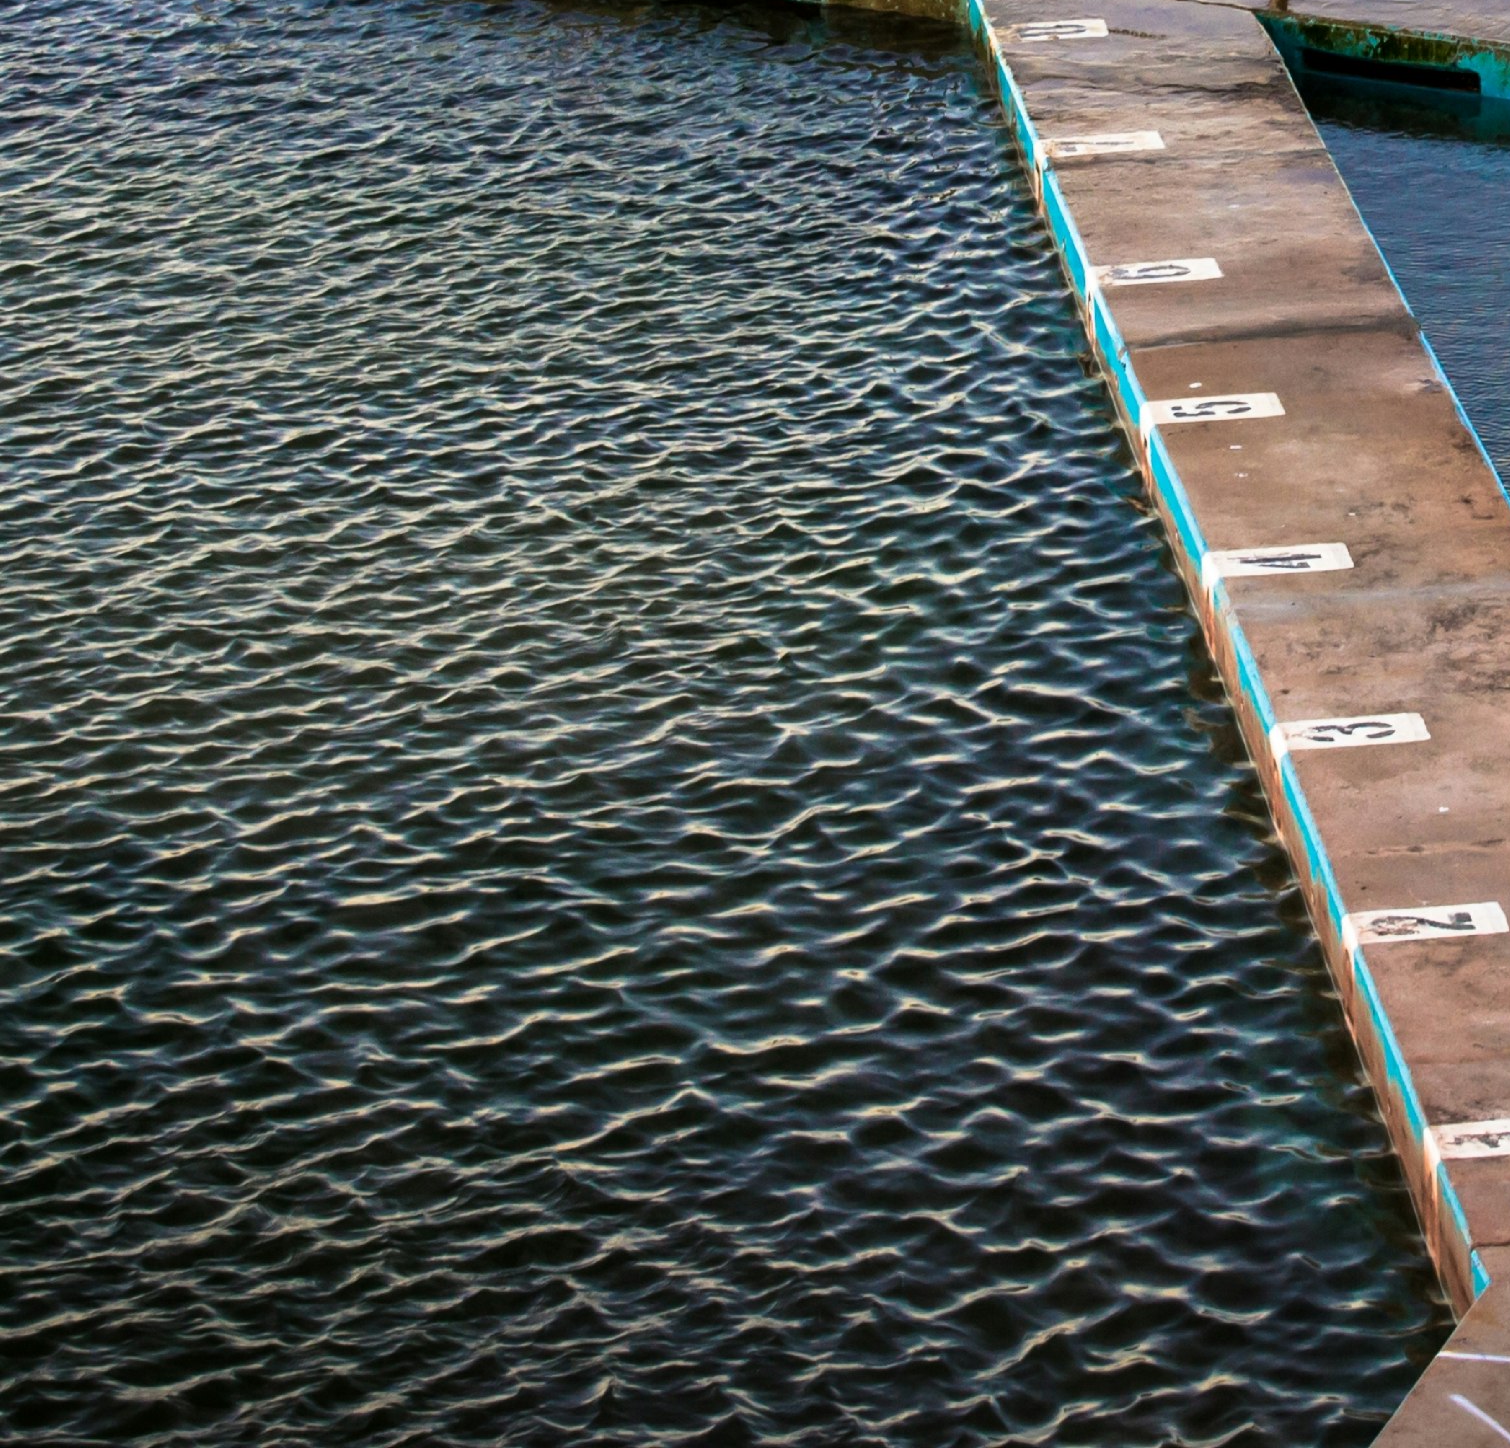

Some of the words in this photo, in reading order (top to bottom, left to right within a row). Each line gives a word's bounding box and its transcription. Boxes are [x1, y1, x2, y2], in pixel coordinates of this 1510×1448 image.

[1170, 401, 1252, 418] 5
[1229, 553, 1322, 569] 4
[1305, 721, 1396, 742] 3
[1370, 912, 1476, 936] 2
